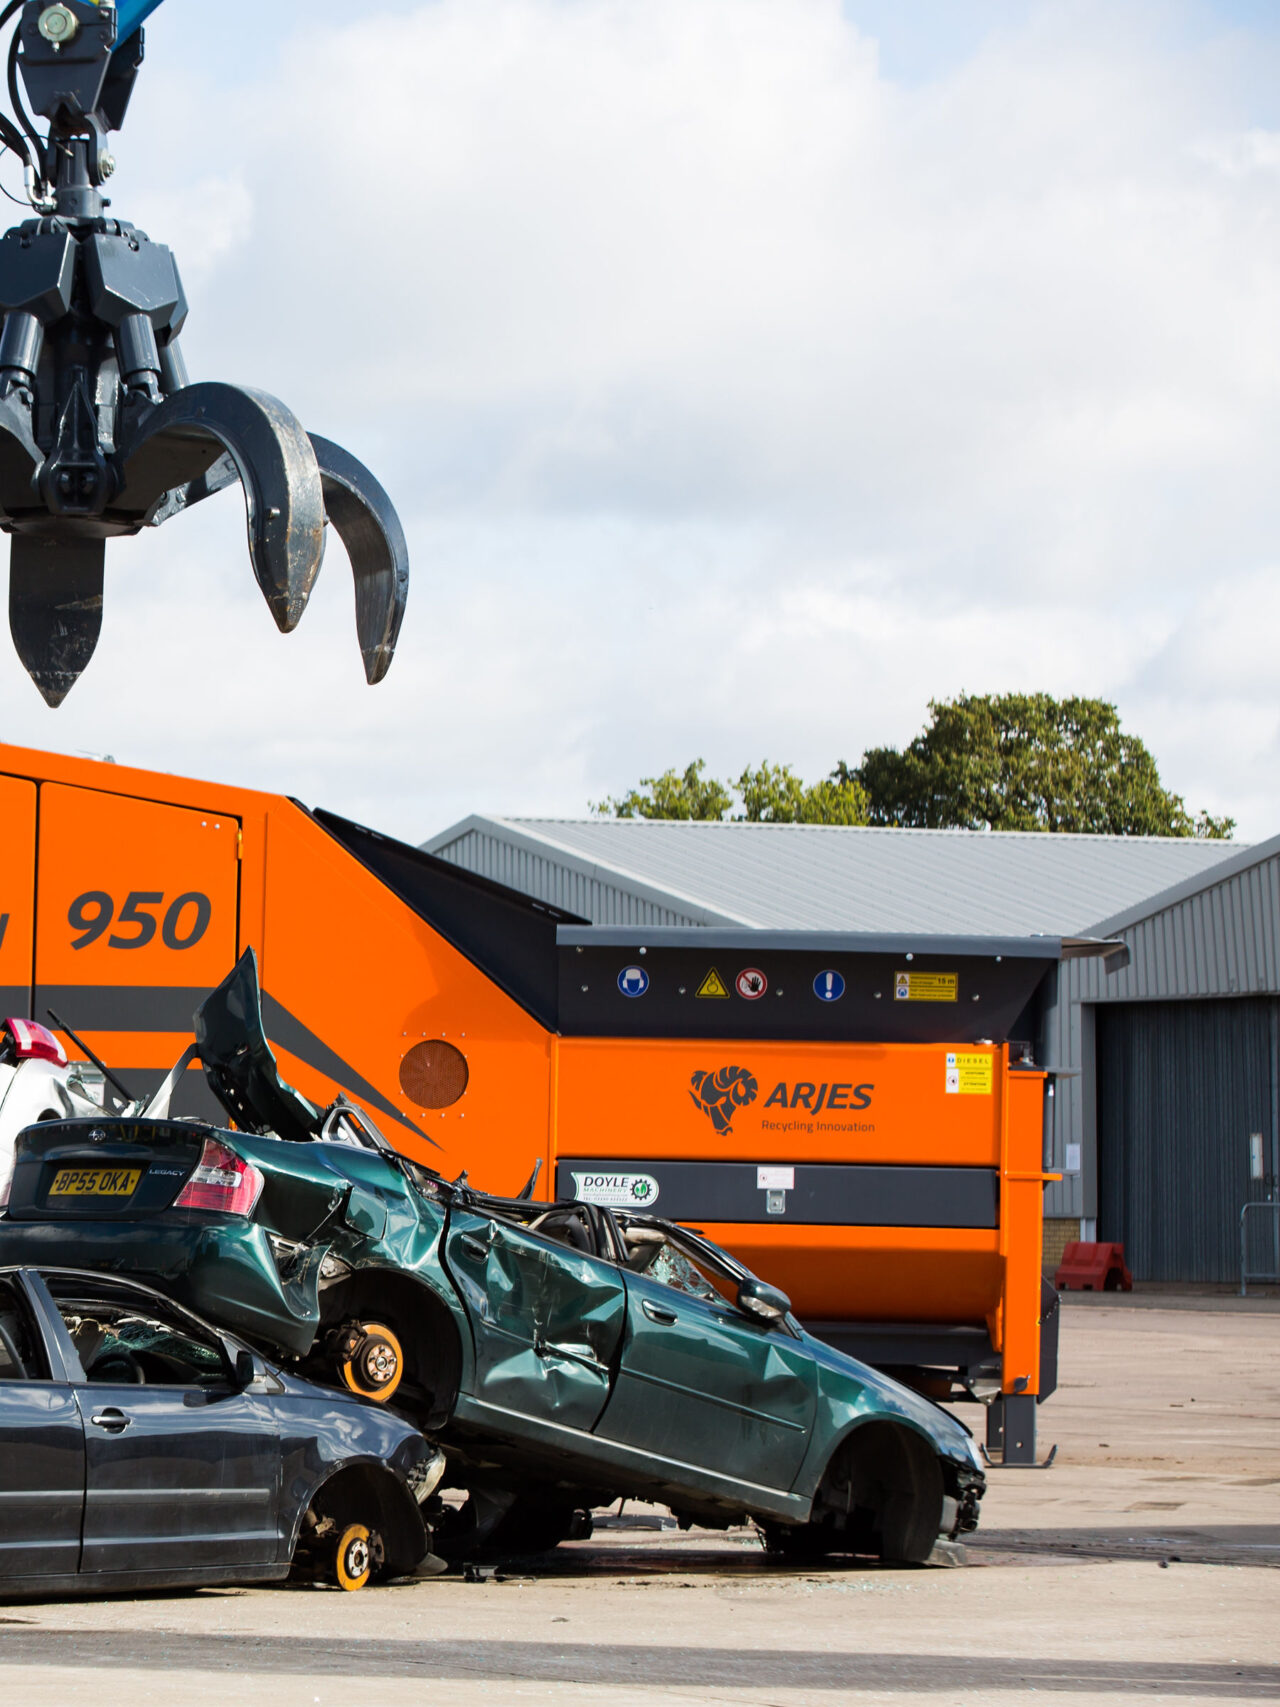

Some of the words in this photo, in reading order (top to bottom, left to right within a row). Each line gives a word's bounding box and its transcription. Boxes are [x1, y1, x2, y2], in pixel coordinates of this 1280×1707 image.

[67, 890, 213, 951] 950
[956, 1057, 989, 1065] DIESEL
[763, 1082, 875, 1116] ARJES
[761, 1120, 814, 1133] Recycling
[816, 1121, 875, 1132] Innovation
[148, 1168, 186, 1177] LEGACY
[55, 1171, 97, 1192] BP55
[99, 1171, 129, 1192] OKA
[584, 1176, 630, 1188] DOYLE
